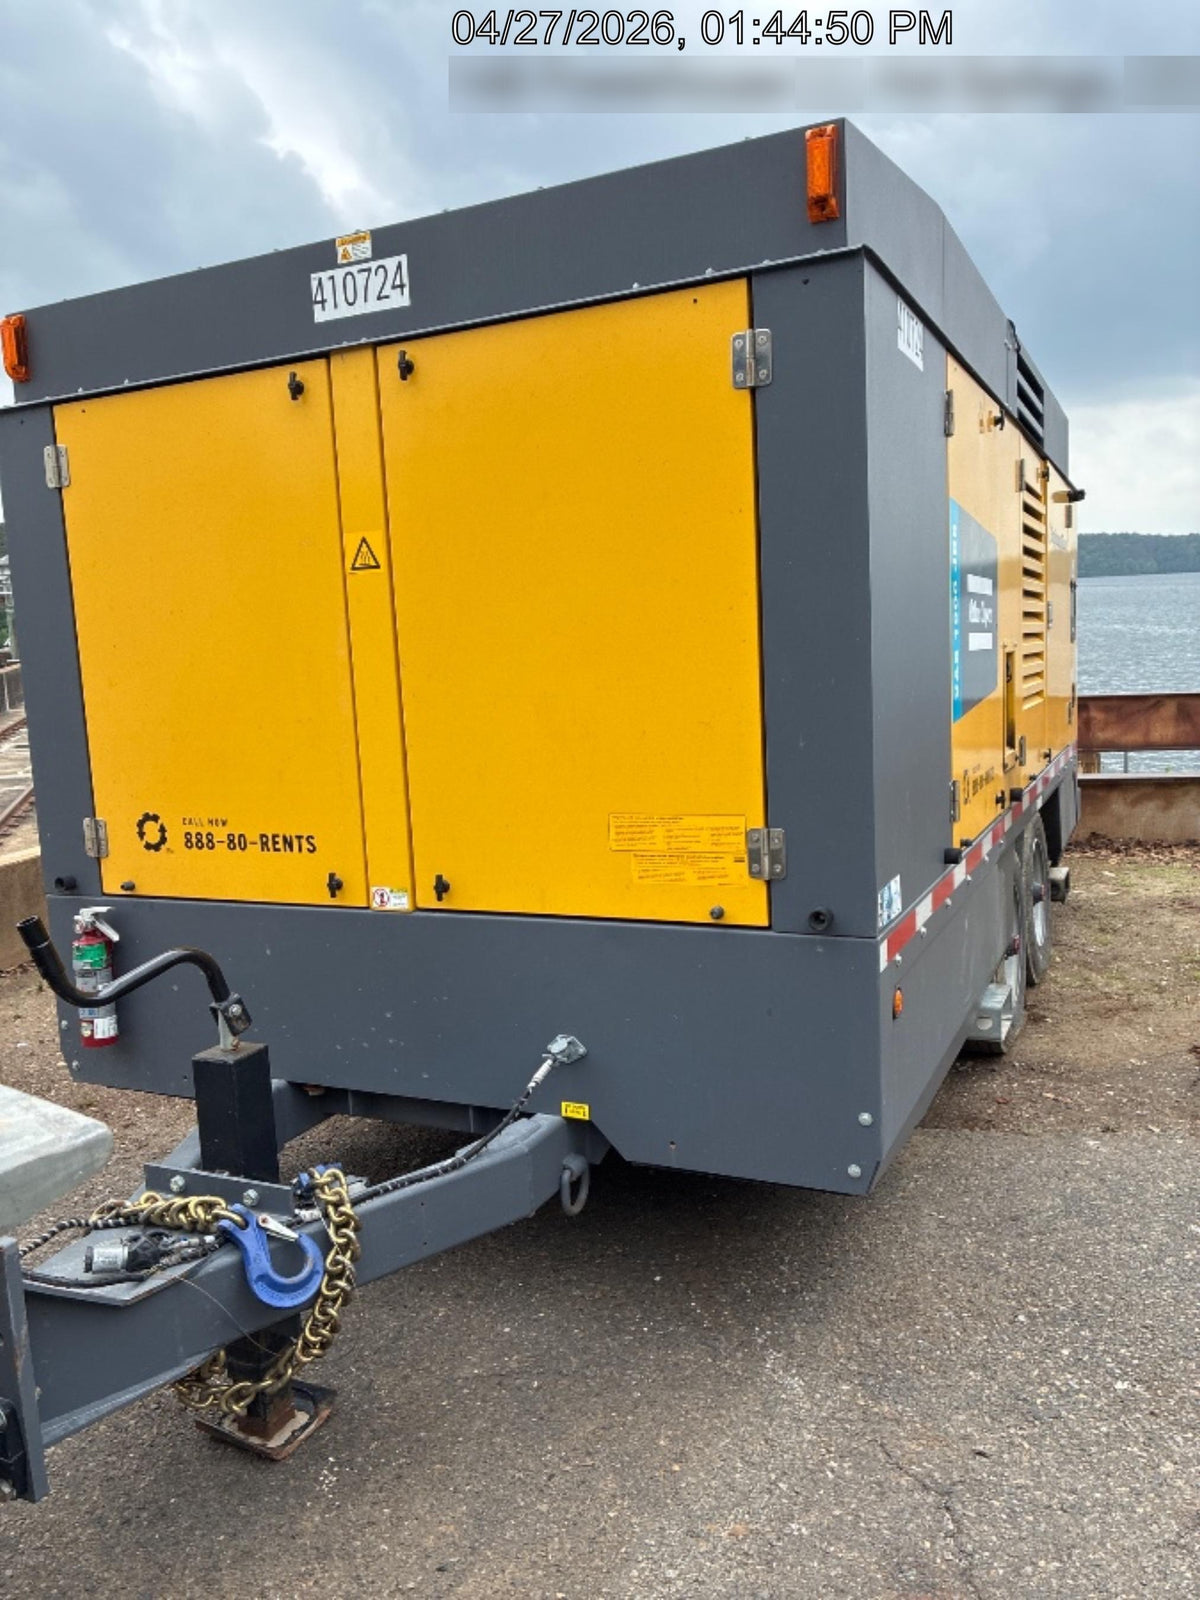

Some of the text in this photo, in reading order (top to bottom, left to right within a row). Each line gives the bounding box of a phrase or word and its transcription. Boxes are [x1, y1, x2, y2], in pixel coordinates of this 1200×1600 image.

[313, 260, 406, 312] 410724
[182, 817, 228, 827] CALL NOW
[184, 831, 316, 854] 888-80-RENTS
